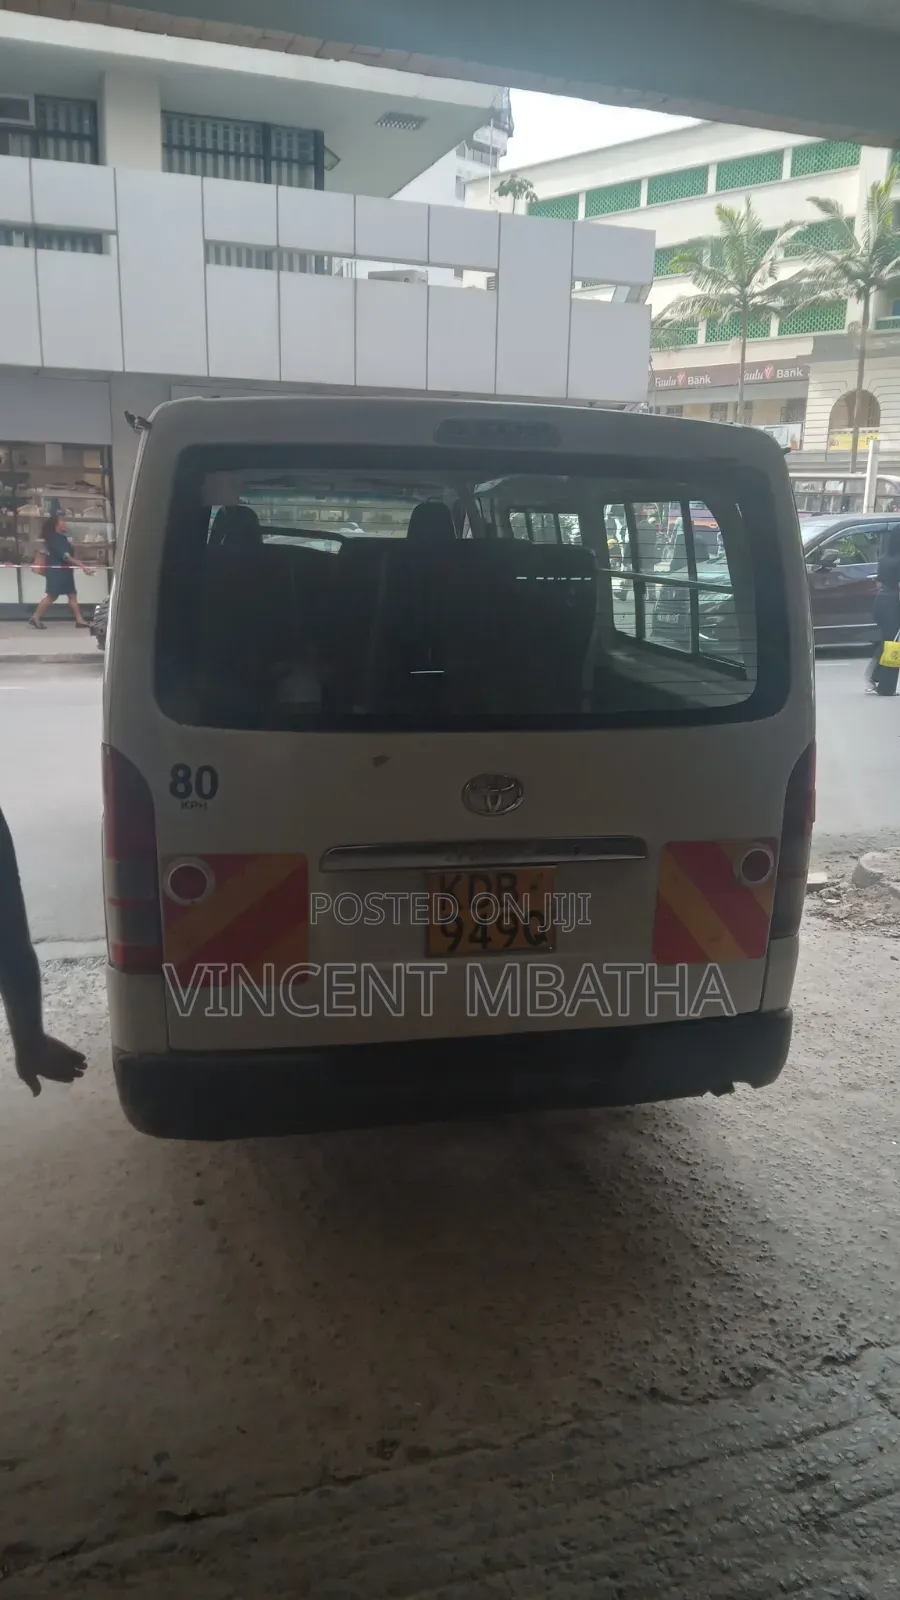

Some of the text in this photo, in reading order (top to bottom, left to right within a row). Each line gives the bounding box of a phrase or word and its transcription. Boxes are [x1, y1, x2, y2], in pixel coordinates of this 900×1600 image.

[687, 374, 711, 386] Bank
[739, 367, 803, 382] aulu Bank
[169, 762, 219, 800] 80
[180, 800, 208, 811] KPH
